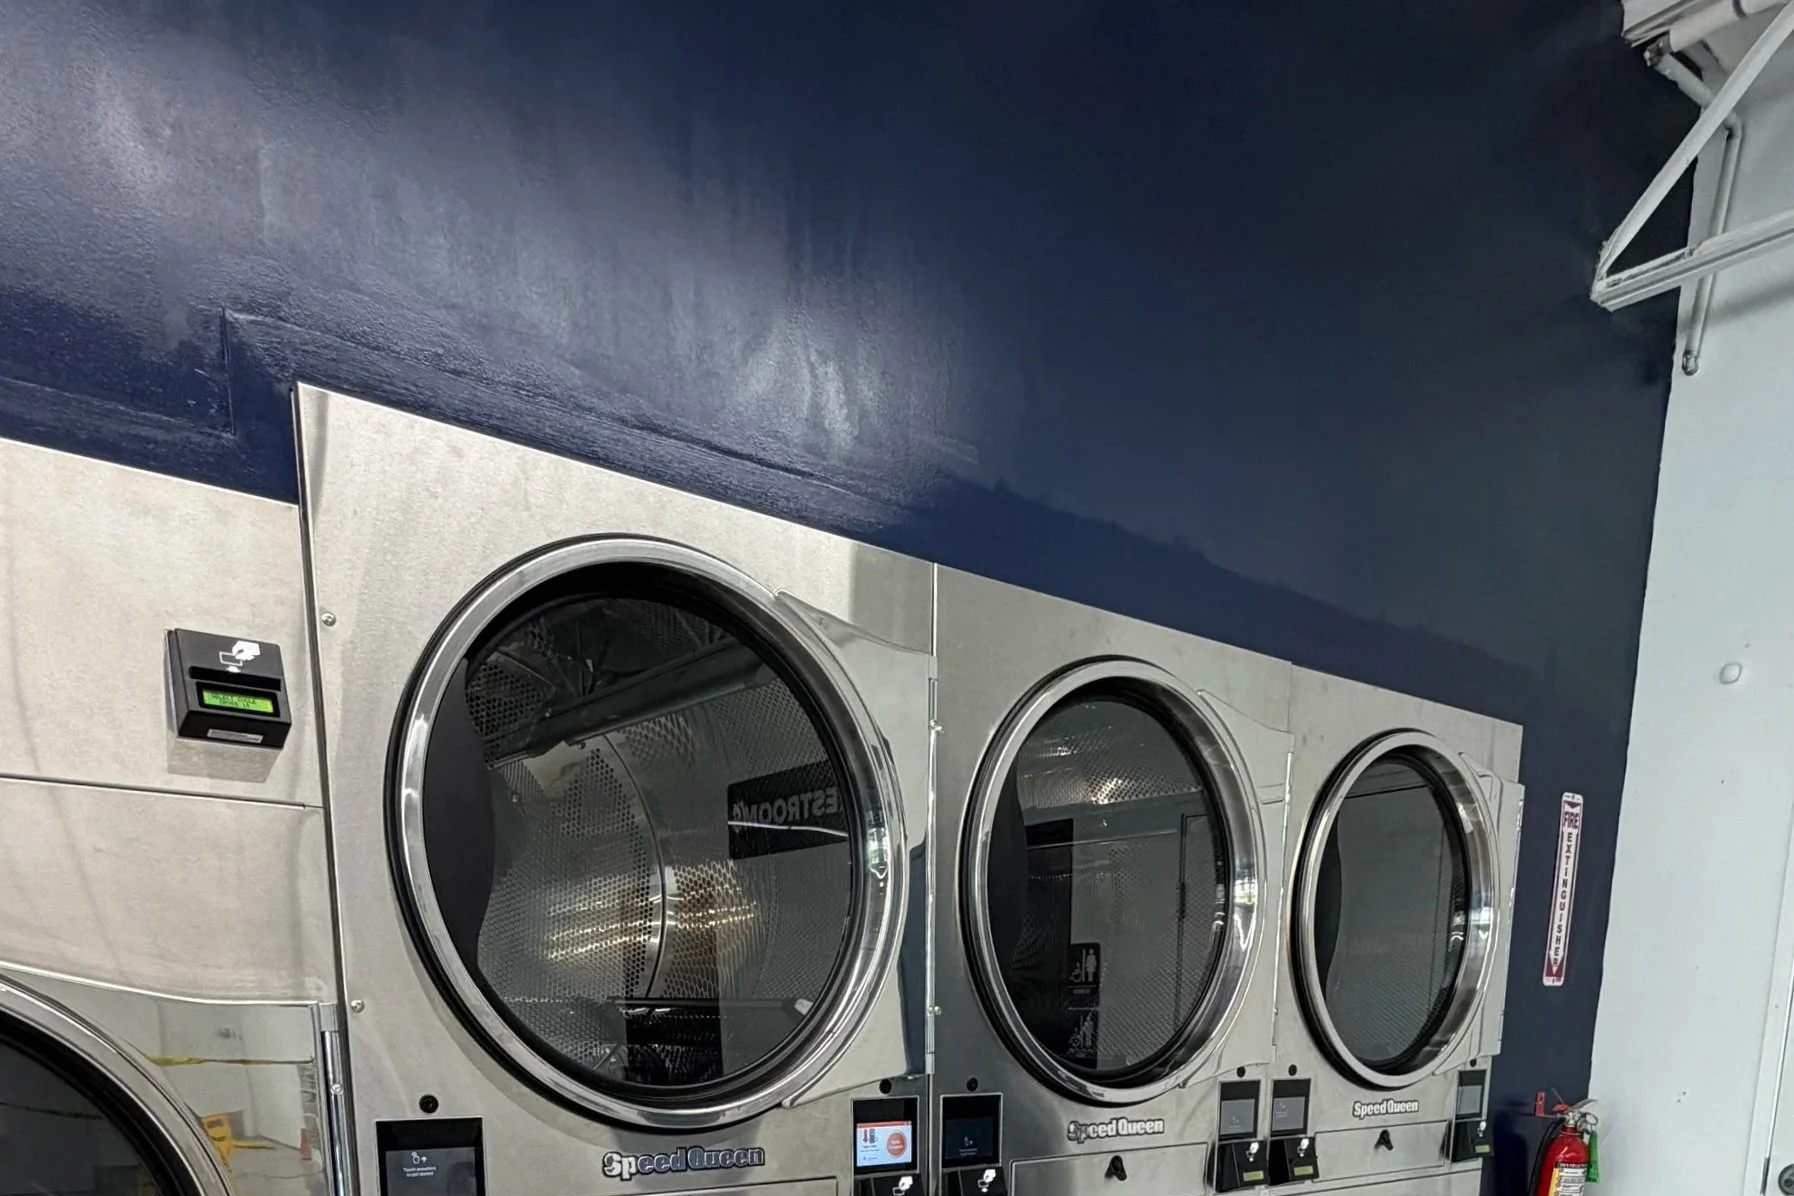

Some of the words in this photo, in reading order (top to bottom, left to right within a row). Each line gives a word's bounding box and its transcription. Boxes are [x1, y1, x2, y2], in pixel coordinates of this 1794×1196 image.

[1563, 811, 1579, 829] FIRE
[1553, 832, 1573, 965] EXTINGUISHER
[1352, 1099, 1387, 1120] Speed
[1387, 1098, 1419, 1115] Queen
[1067, 1118, 1117, 1144] Speed
[1117, 1117, 1164, 1136] Queen
[603, 1147, 688, 1181] Speed
[688, 1145, 765, 1170] Queen
